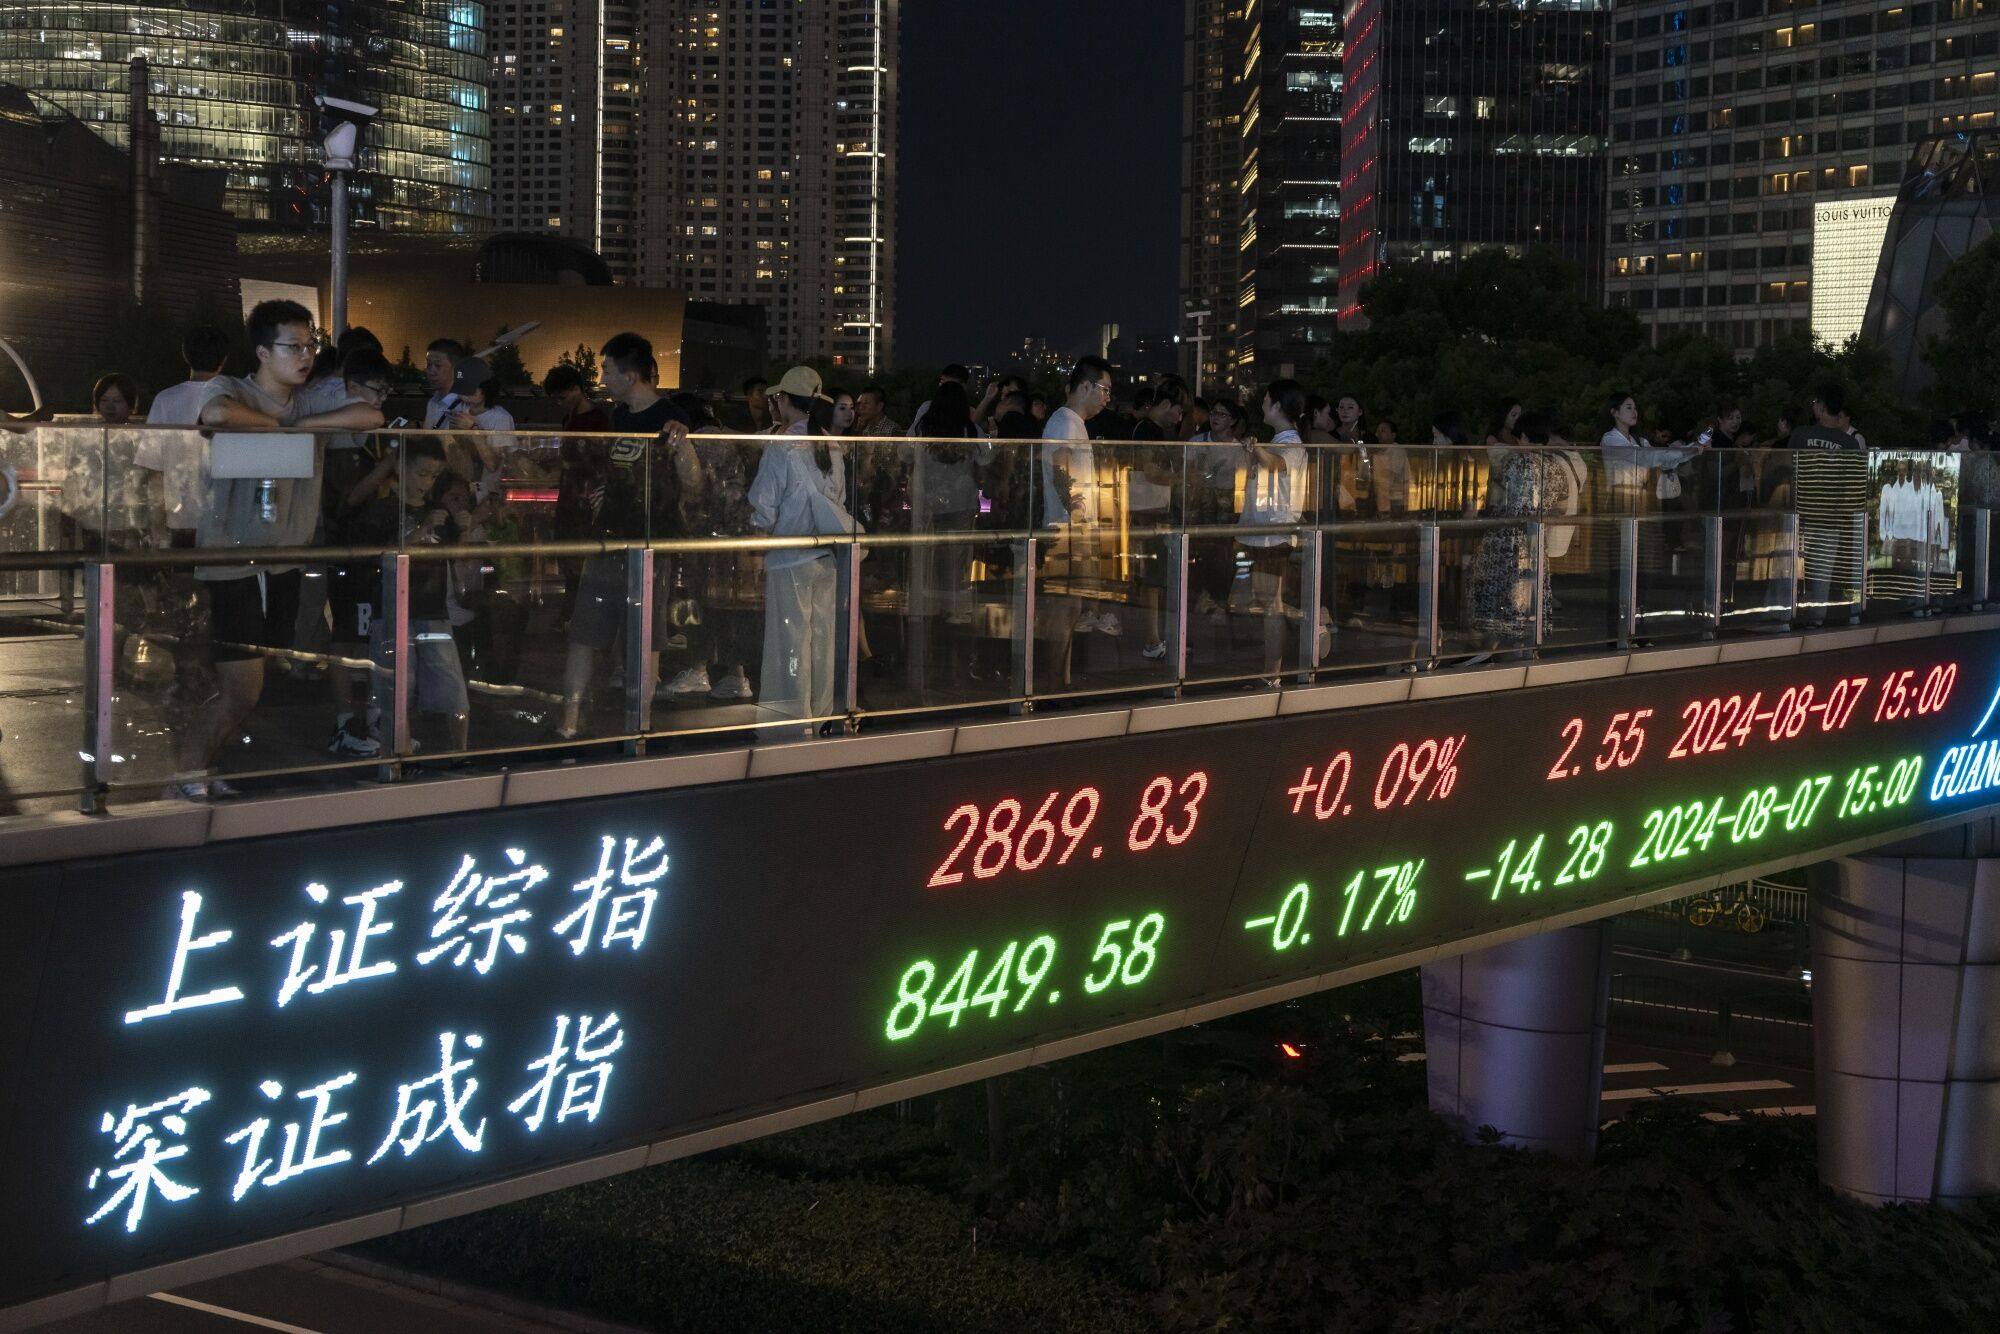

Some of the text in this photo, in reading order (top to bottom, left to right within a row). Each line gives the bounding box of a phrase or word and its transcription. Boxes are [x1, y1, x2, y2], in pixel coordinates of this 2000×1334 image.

[1817, 206, 1892, 222] LOUIS VUITTO
[85, 1004, 625, 1233] 深证成指
[1629, 775, 1832, 868] 2024-08-07
[1838, 755, 1923, 818] 15:00
[124, 835, 670, 1025] 上证综指
[1667, 678, 1869, 759] 2024-08-07
[1874, 663, 1957, 722] 15:00
